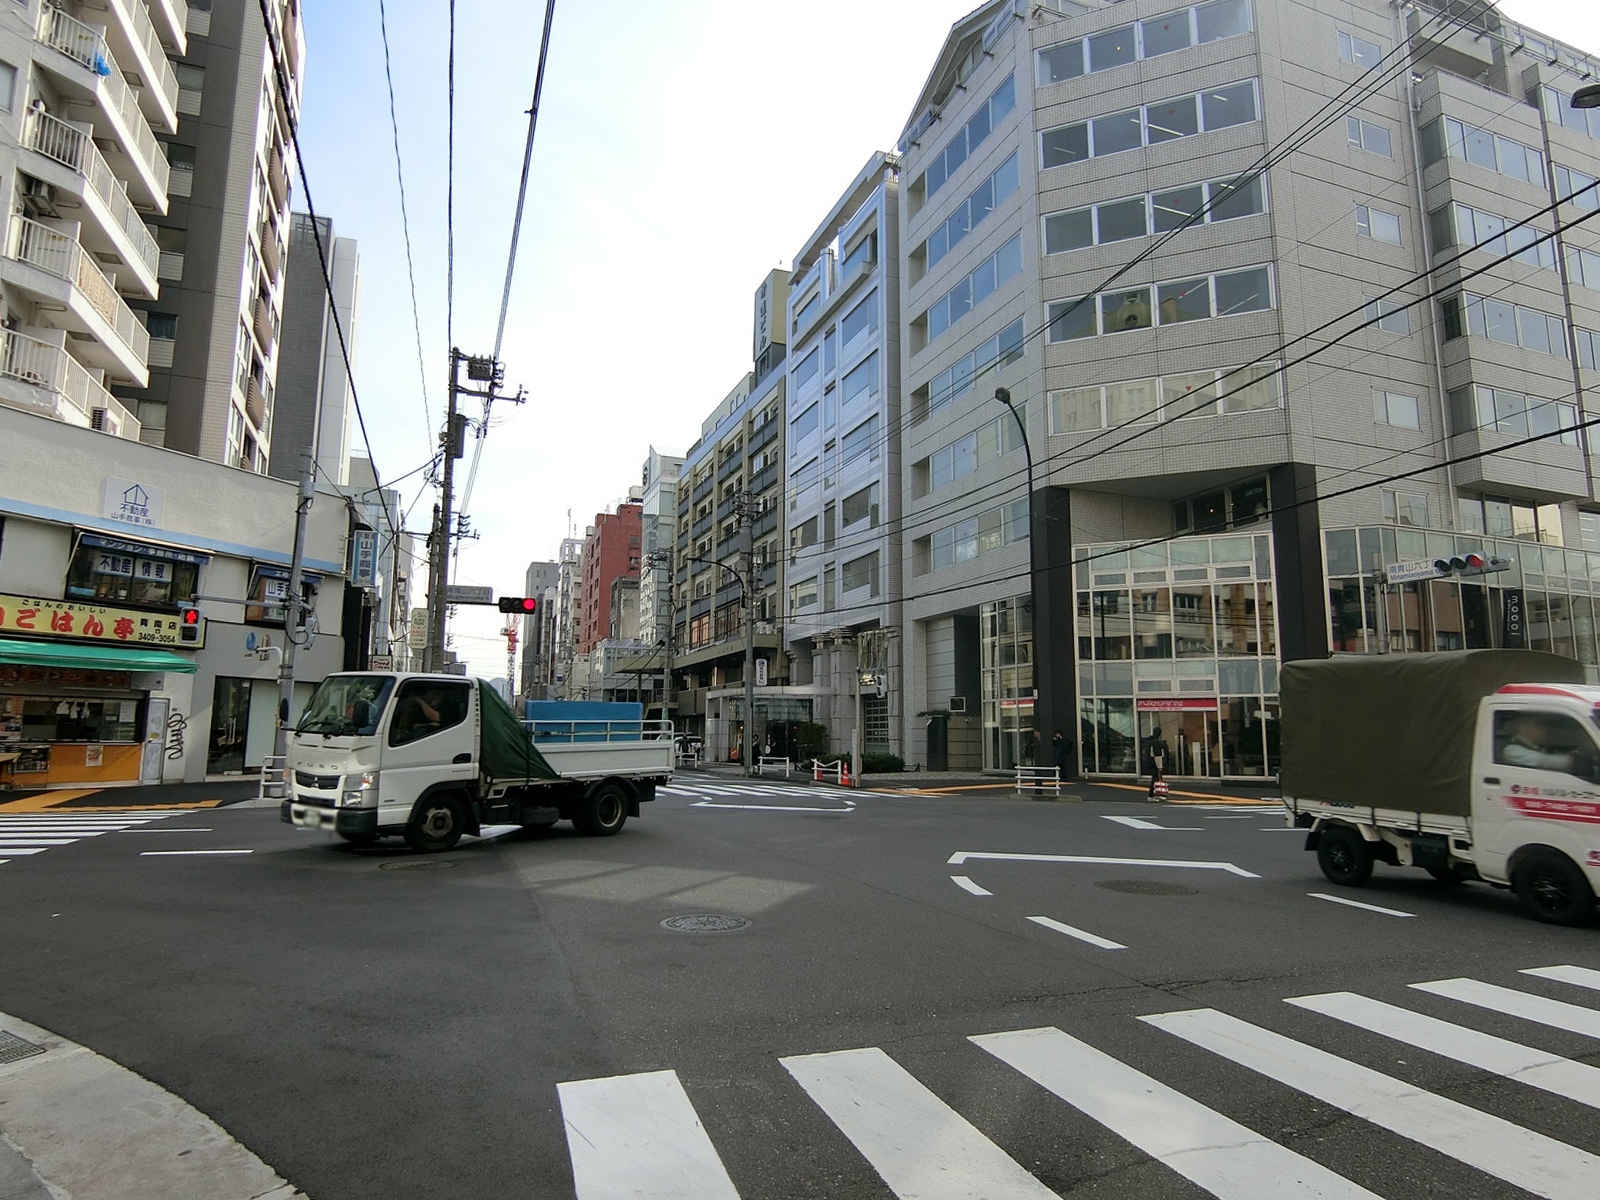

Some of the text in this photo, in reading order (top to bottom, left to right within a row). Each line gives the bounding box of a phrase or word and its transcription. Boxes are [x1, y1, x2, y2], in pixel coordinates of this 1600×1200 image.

[120, 503, 149, 517] 不動産
[100, 554, 165, 579] 不動産 情報
[1510, 595, 1520, 635] moooi
[138, 632, 176, 643] 3409-3054
[297, 762, 338, 770] FUSO
